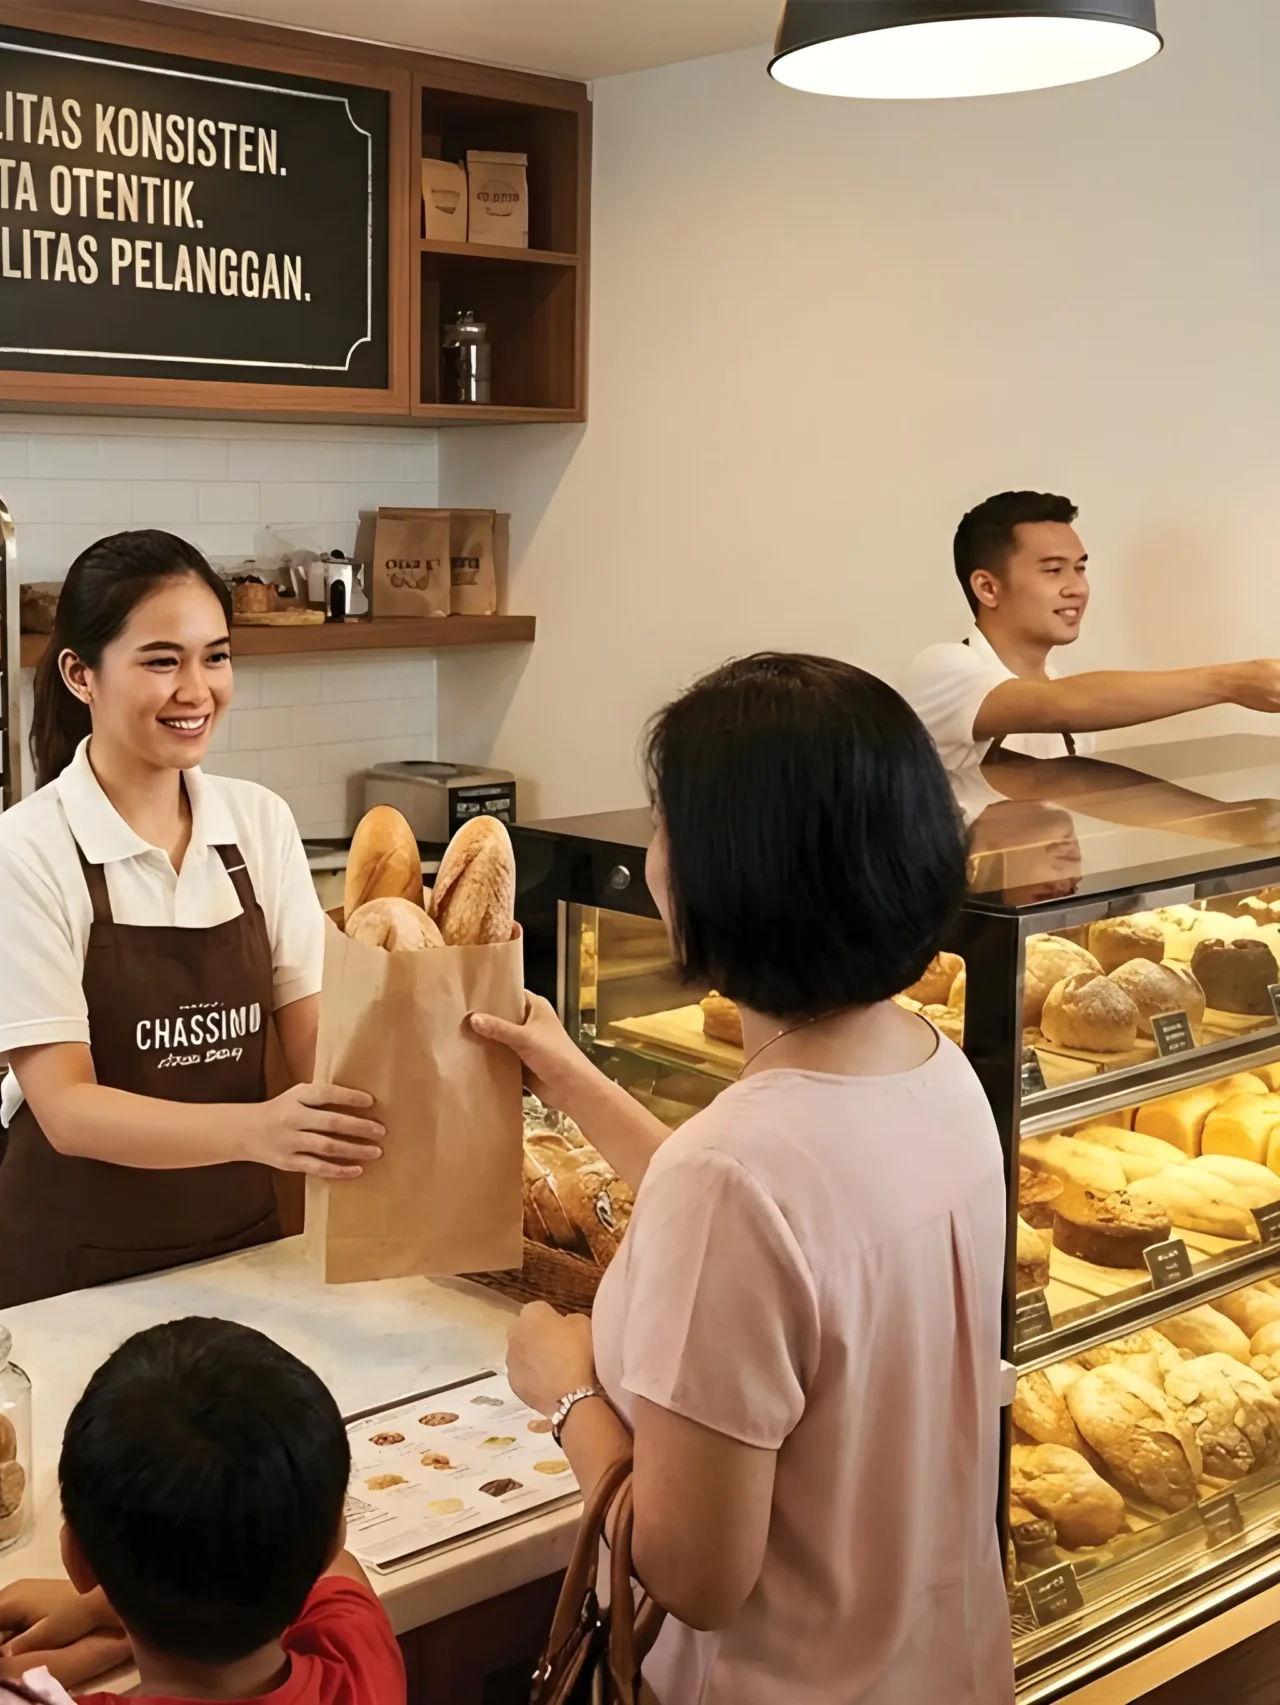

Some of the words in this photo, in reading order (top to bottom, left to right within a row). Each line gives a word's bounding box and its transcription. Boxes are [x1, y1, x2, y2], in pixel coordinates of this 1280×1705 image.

[95, 102, 287, 177] KONSISTEN.
[49, 164, 204, 229] OTENTIK.
[111, 237, 311, 302] PELANGGAN.
